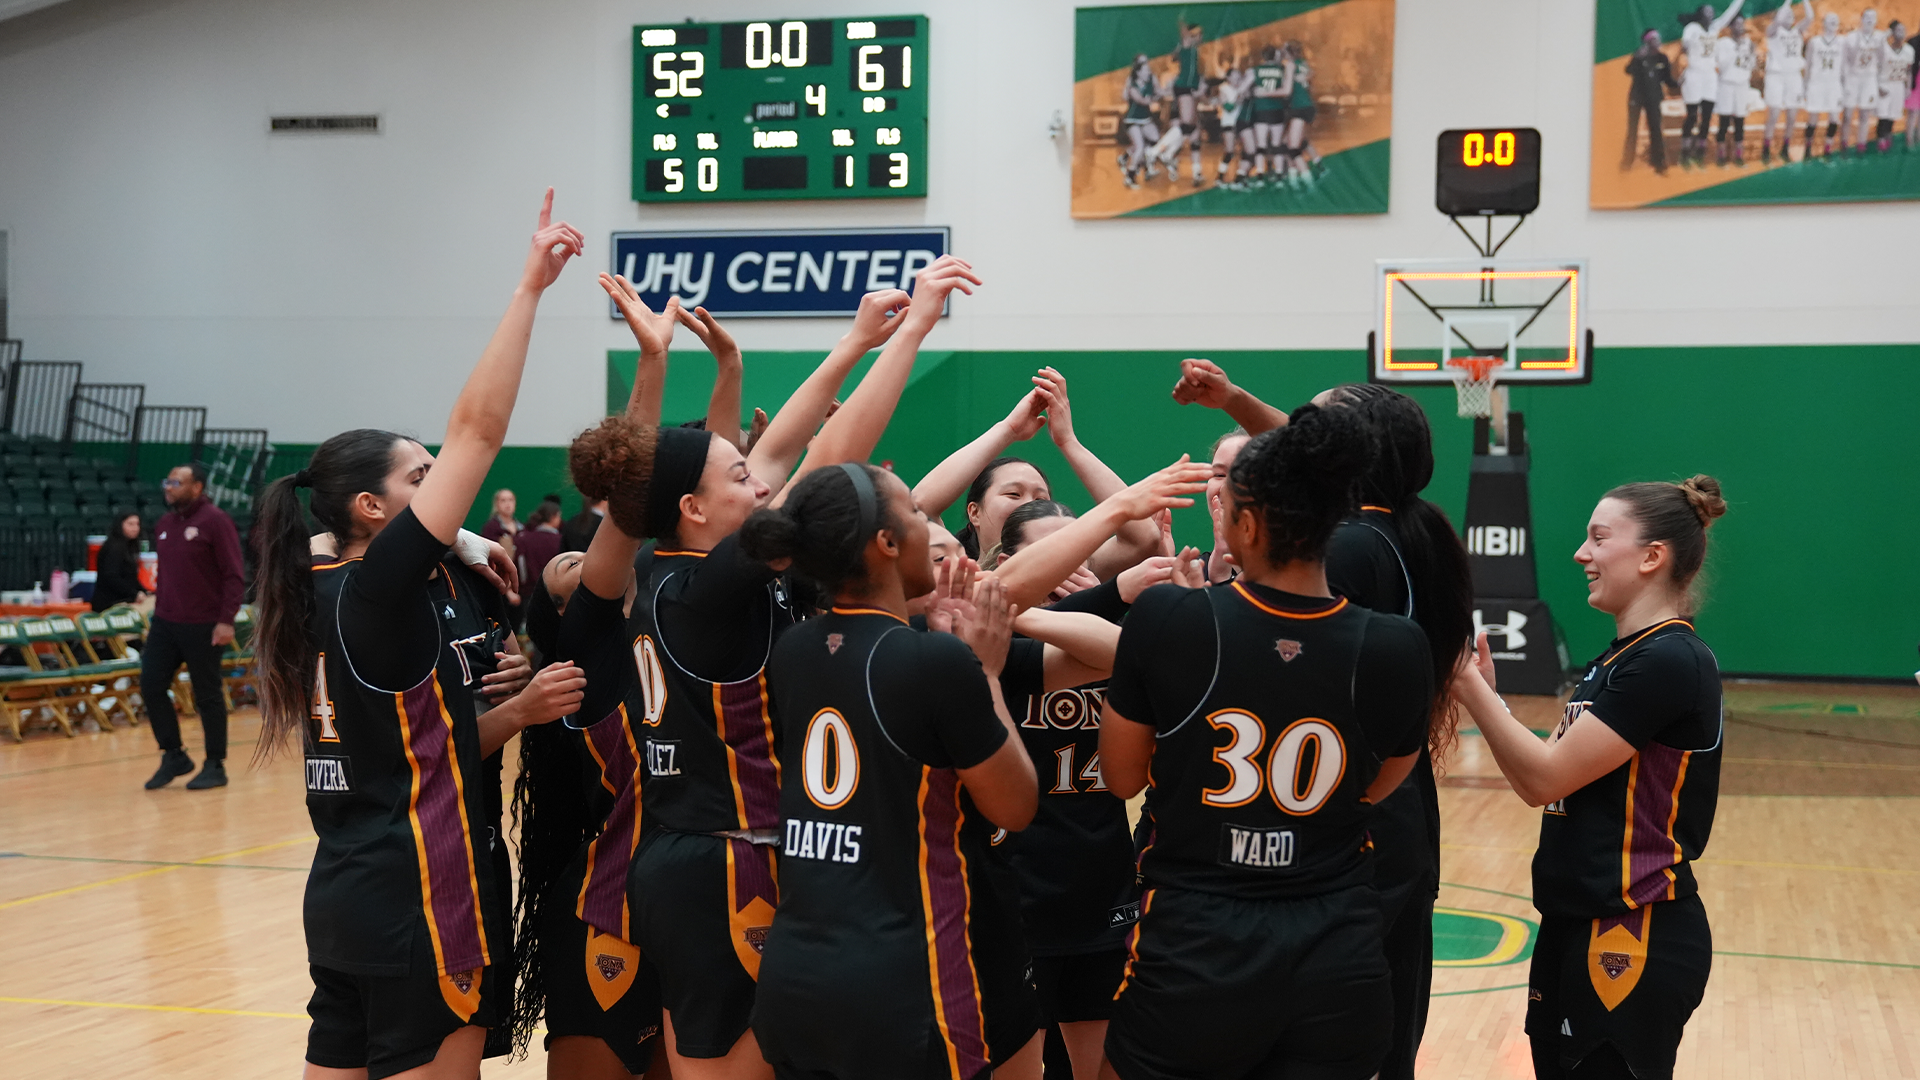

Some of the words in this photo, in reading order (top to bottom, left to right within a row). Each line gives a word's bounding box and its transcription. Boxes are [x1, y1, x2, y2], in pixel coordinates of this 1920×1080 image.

[746, 21, 807, 68] 0.0
[653, 51, 704, 97] 52
[858, 45, 911, 91] 61
[805, 84, 826, 116] 4
[888, 152, 908, 188] 3
[1462, 131, 1516, 167] 0.0
[663, 158, 684, 192] 5
[698, 157, 718, 191] 0
[845, 155, 854, 187] 1
[310, 651, 341, 743] 4
[1020, 688, 1110, 731] ION
[802, 707, 860, 810] 0
[1202, 707, 1348, 817] 30
[785, 819, 862, 864] DAVIS
[1230, 827, 1295, 867] WARD
